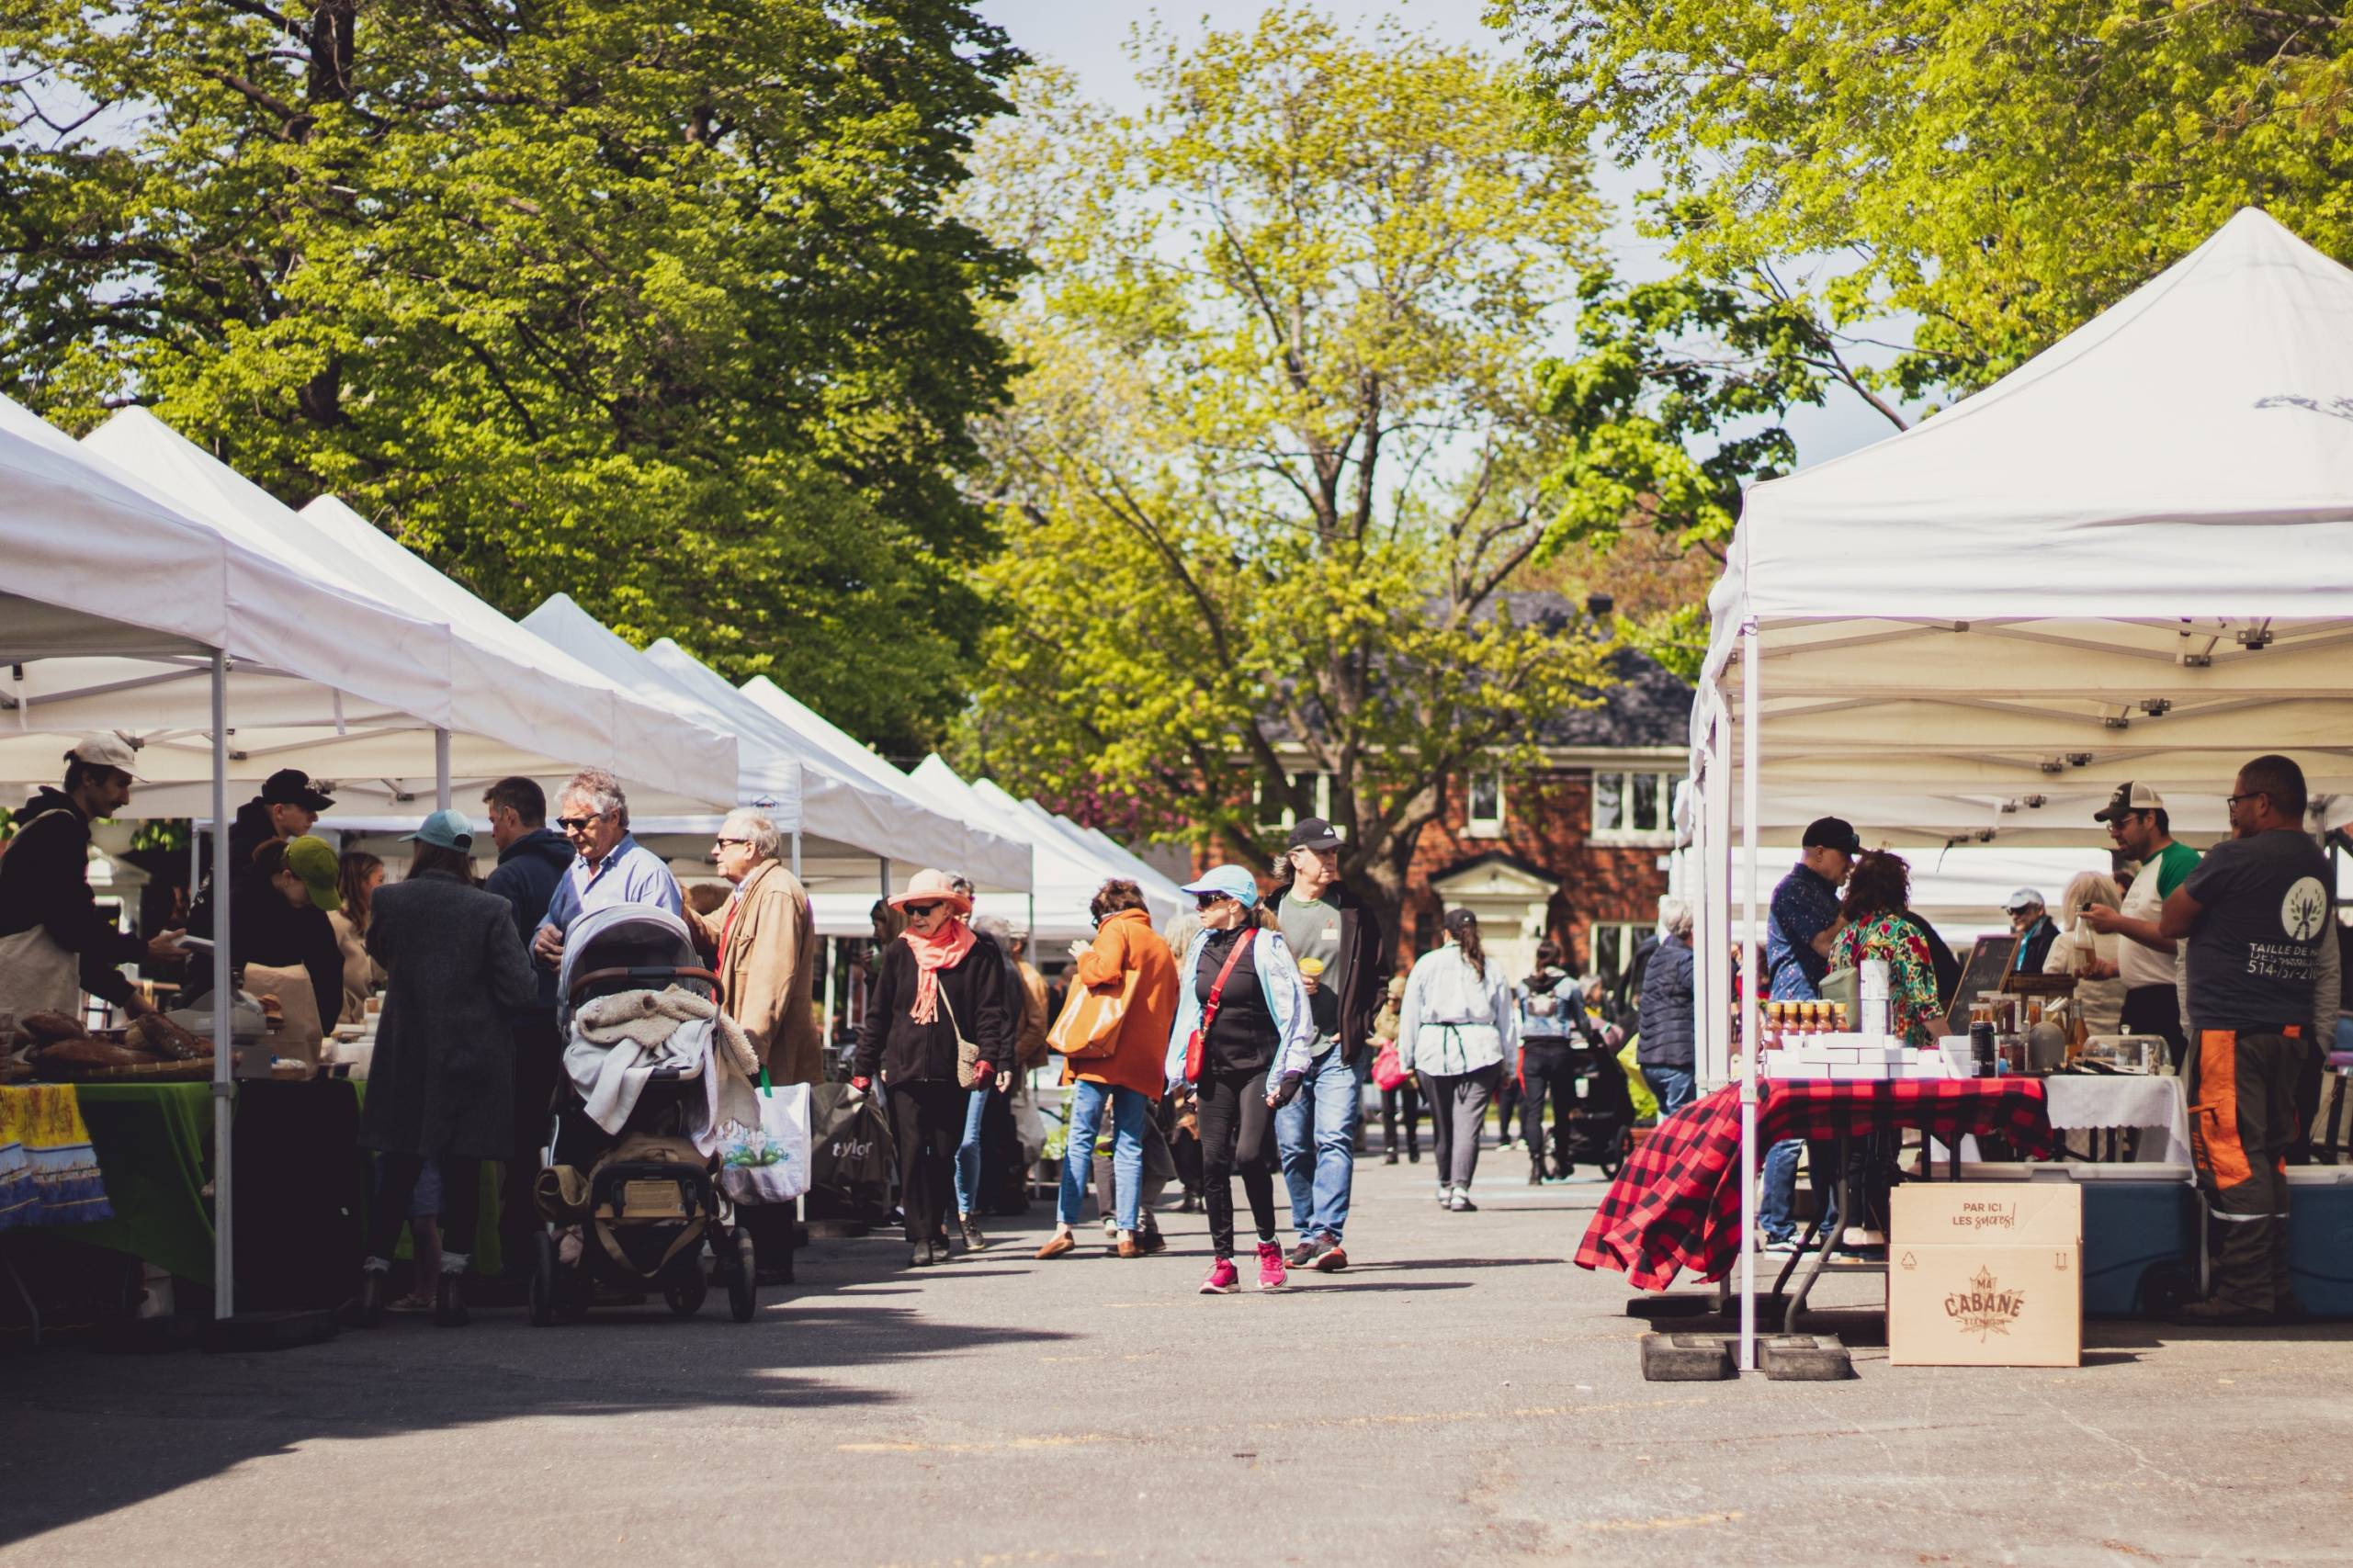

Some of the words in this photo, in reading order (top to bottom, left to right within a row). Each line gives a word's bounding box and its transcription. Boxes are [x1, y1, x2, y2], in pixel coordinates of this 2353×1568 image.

[2249, 942, 2291, 955] TAILLE
[2293, 946, 2308, 957] DE
[1963, 1202, 1985, 1213] PAR
[1987, 1202, 2002, 1213] ICI
[1952, 1216, 1973, 1225] LES
[1976, 1280, 1992, 1289] MA
[1944, 1292, 2025, 1317] CABANE
